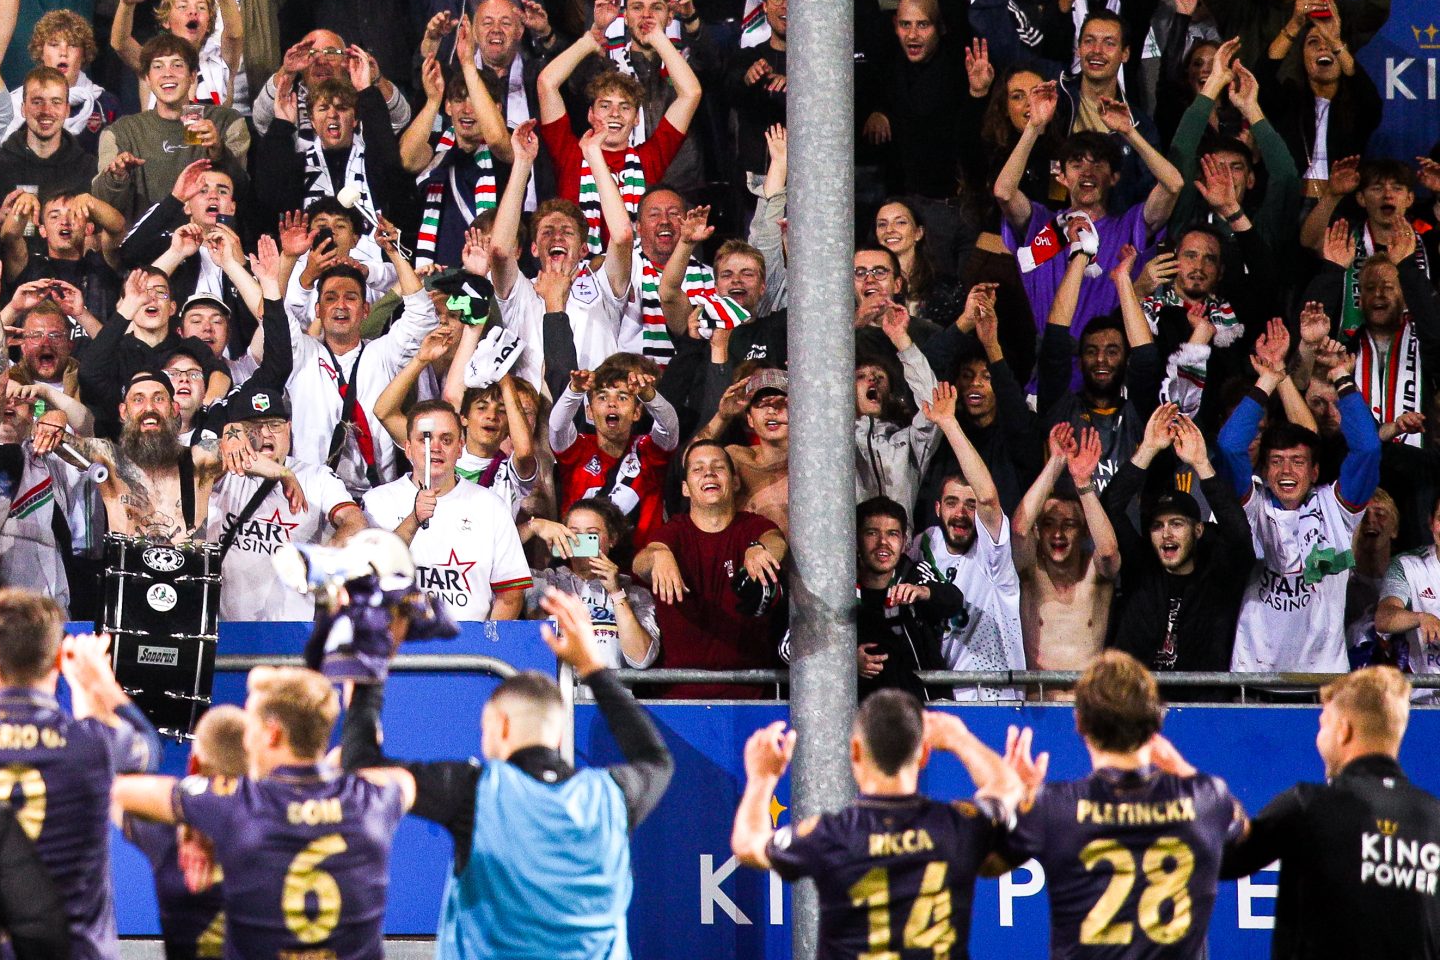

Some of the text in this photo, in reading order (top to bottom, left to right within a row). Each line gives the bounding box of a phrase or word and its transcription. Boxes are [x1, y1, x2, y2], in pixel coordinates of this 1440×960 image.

[1034, 234, 1052, 247] OHL
[416, 565, 463, 592] TAR
[1261, 568, 1310, 599] STAR
[1259, 589, 1311, 613] CASINO
[139, 648, 176, 664] Sonorus
[869, 828, 934, 857] RICCA
[1361, 831, 1440, 873] KING
[281, 833, 348, 945] 6
[1077, 836, 1196, 945] 28
[1360, 860, 1439, 897] POWER
[847, 860, 957, 960] 14
